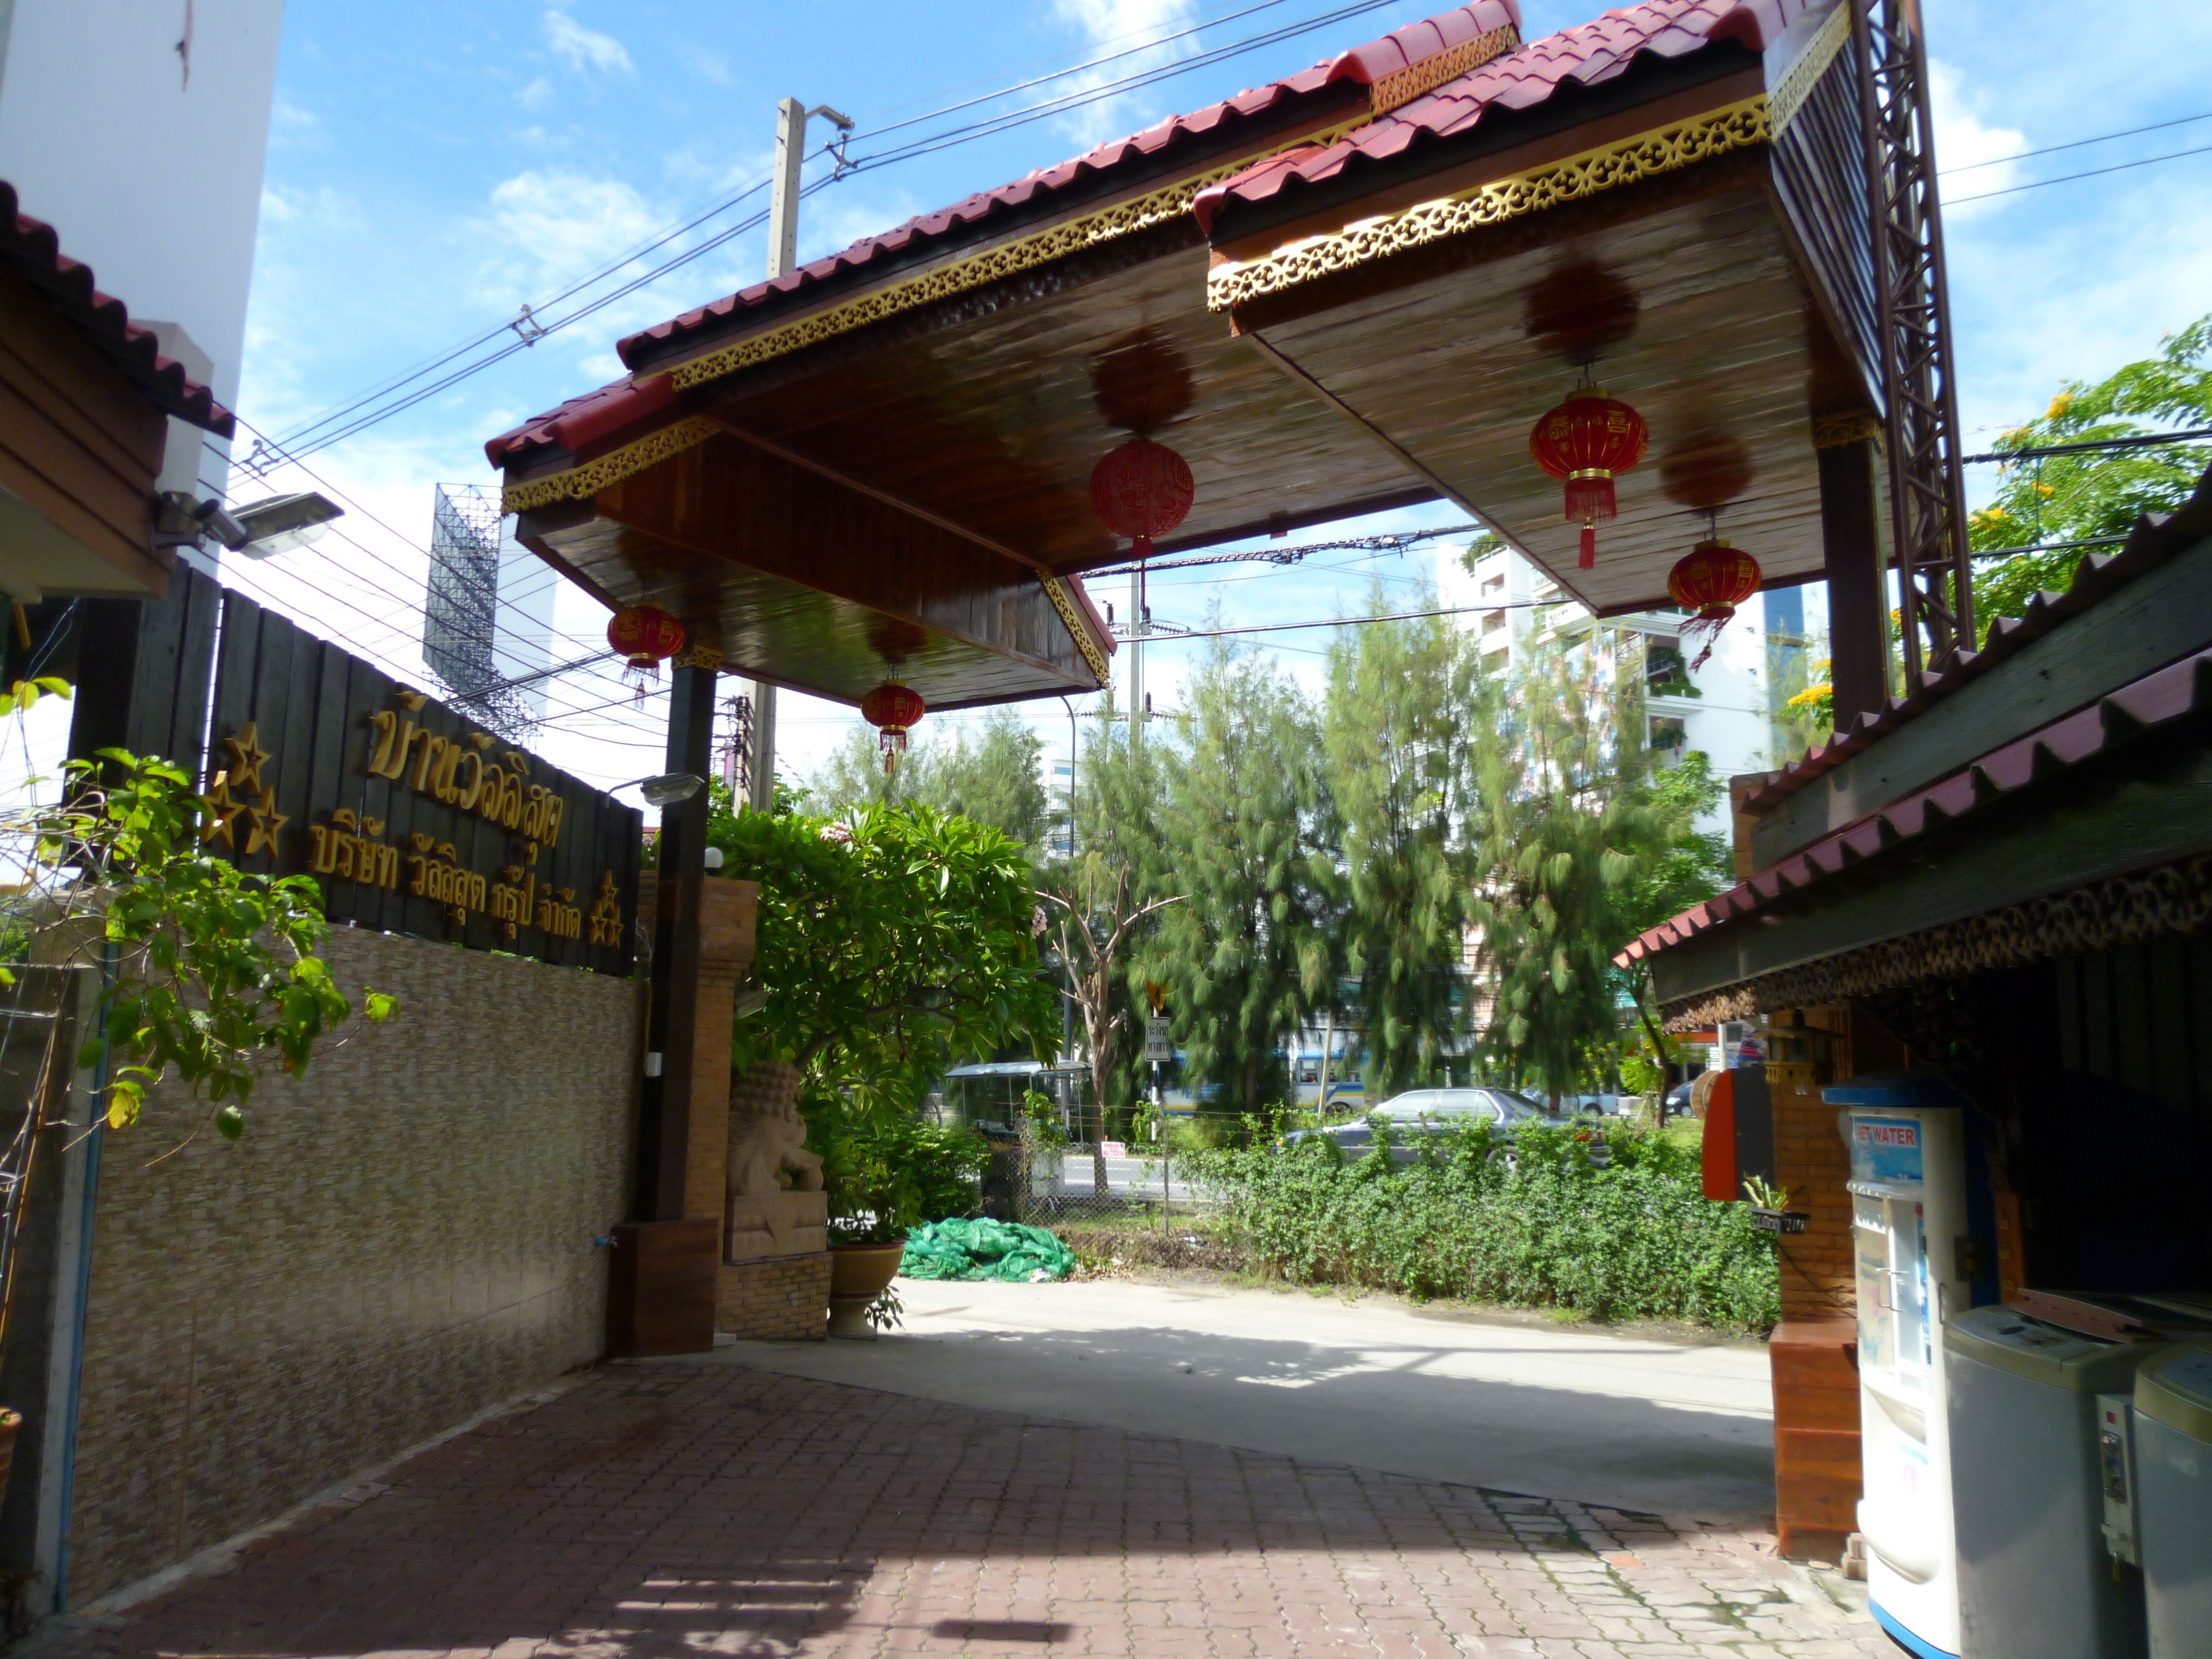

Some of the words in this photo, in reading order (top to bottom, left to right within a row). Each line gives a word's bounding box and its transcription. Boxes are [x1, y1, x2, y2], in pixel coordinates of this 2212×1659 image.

[308, 808, 398, 889] บริษัท
[536, 883, 581, 940] จำกัด
[1873, 1126, 1916, 1146] WATER
